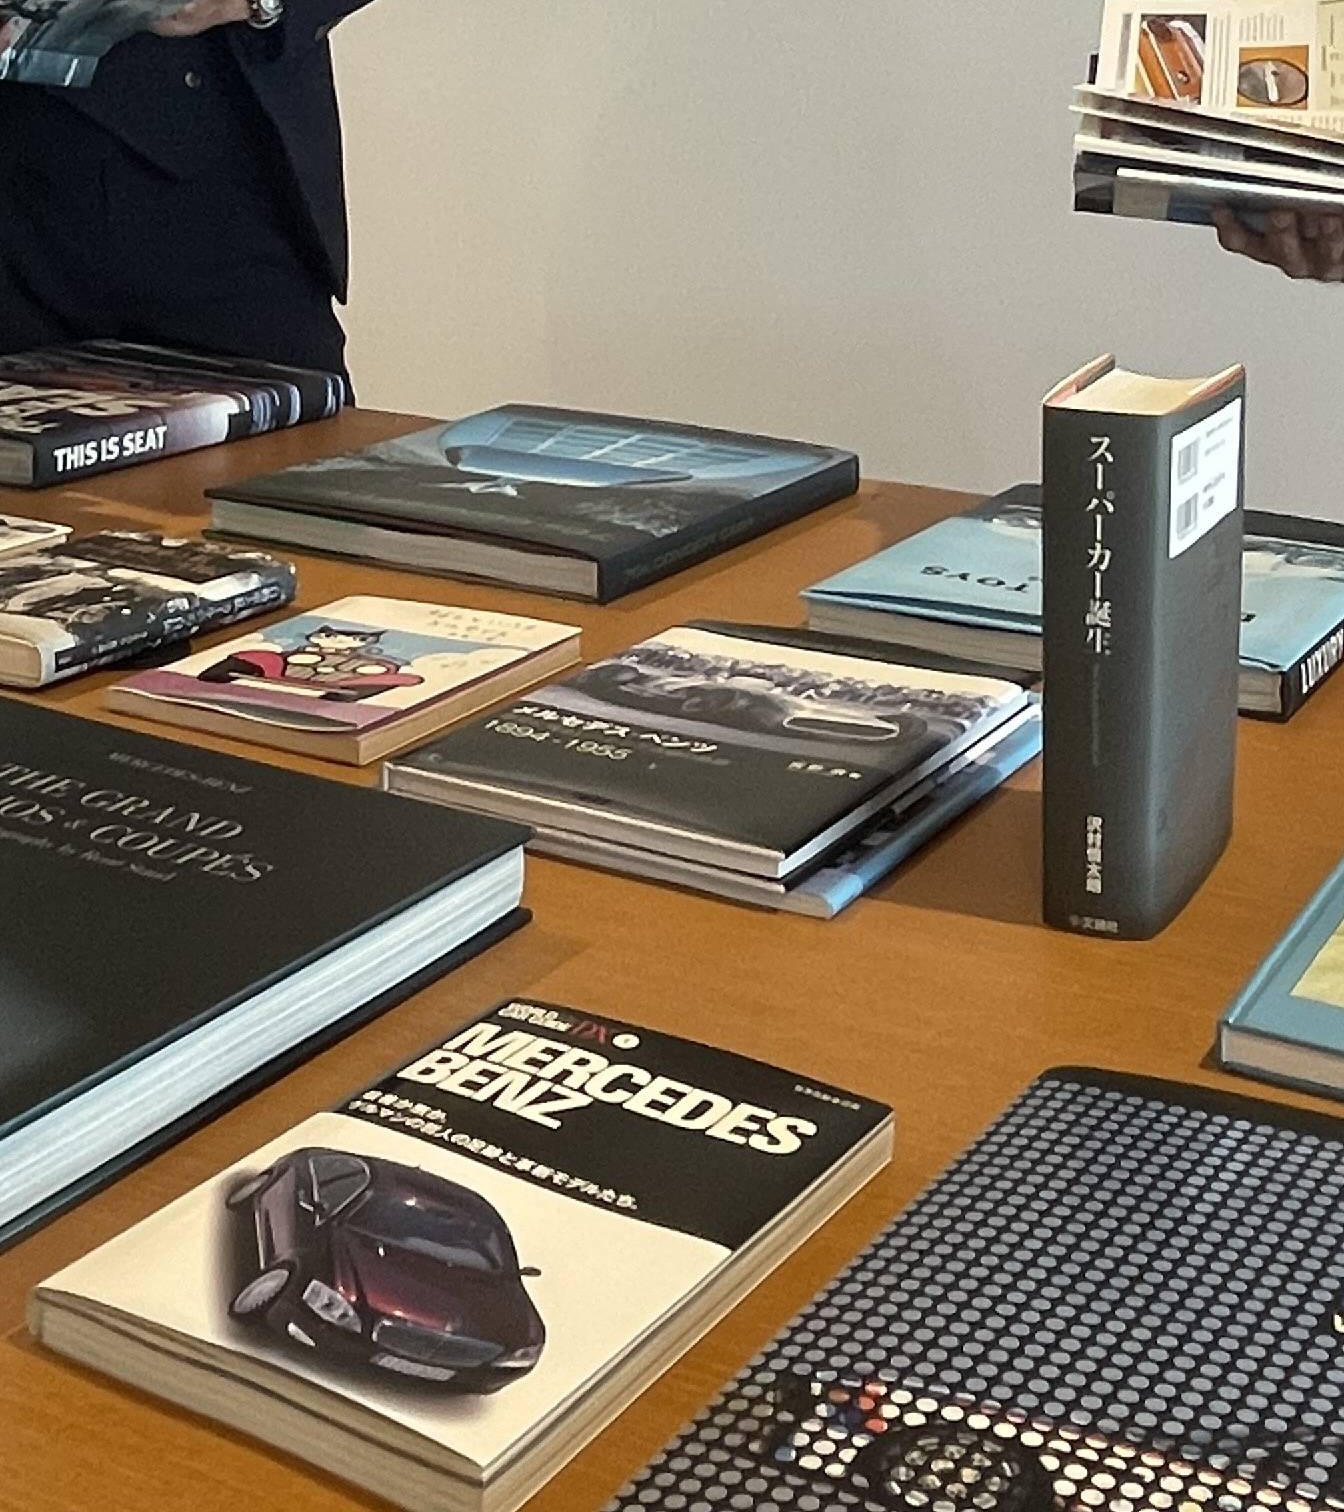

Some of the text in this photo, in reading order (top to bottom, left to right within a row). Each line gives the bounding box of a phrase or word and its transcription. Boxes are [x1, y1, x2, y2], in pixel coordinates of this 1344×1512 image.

[54, 425, 168, 472] THIS IS SEAT
[1086, 436, 1116, 656] スーパーカー誕生
[1300, 628, 1344, 694] LUXURY
[80, 788, 244, 841] GRAND
[396, 1048, 595, 1131] BENZ
[443, 1021, 819, 1158] MERCEDES
